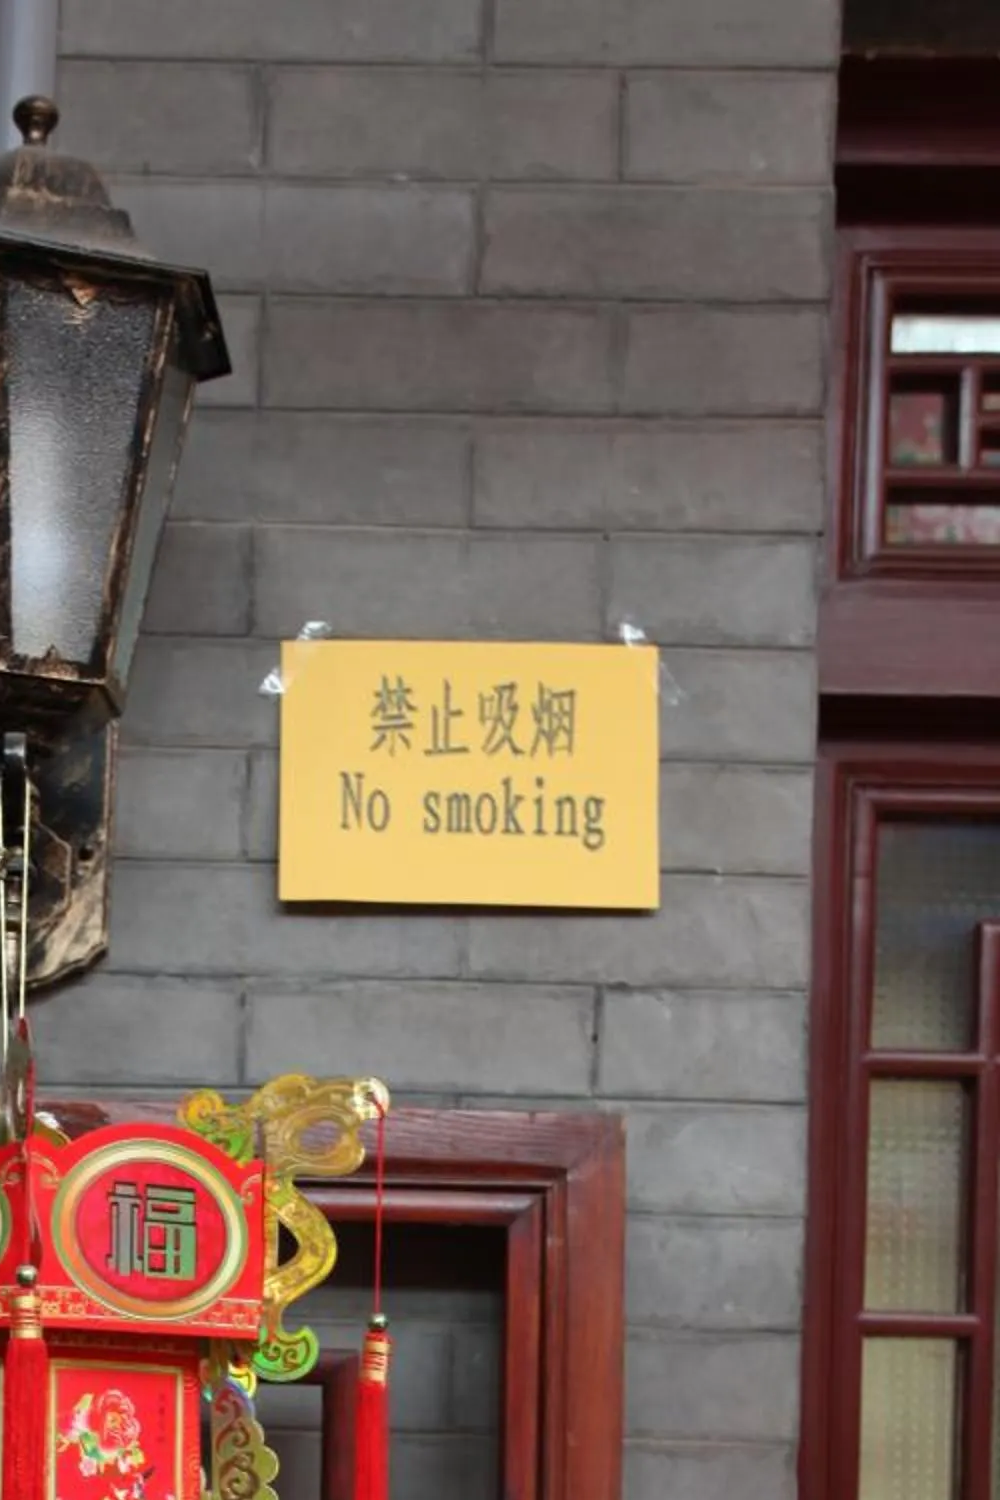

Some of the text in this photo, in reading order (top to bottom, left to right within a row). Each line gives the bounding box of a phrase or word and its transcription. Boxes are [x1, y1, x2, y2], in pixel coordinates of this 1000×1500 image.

[369, 674, 578, 759] 禁止吸烟
[339, 770, 606, 851] No smoking
[105, 1179, 197, 1281] 福
